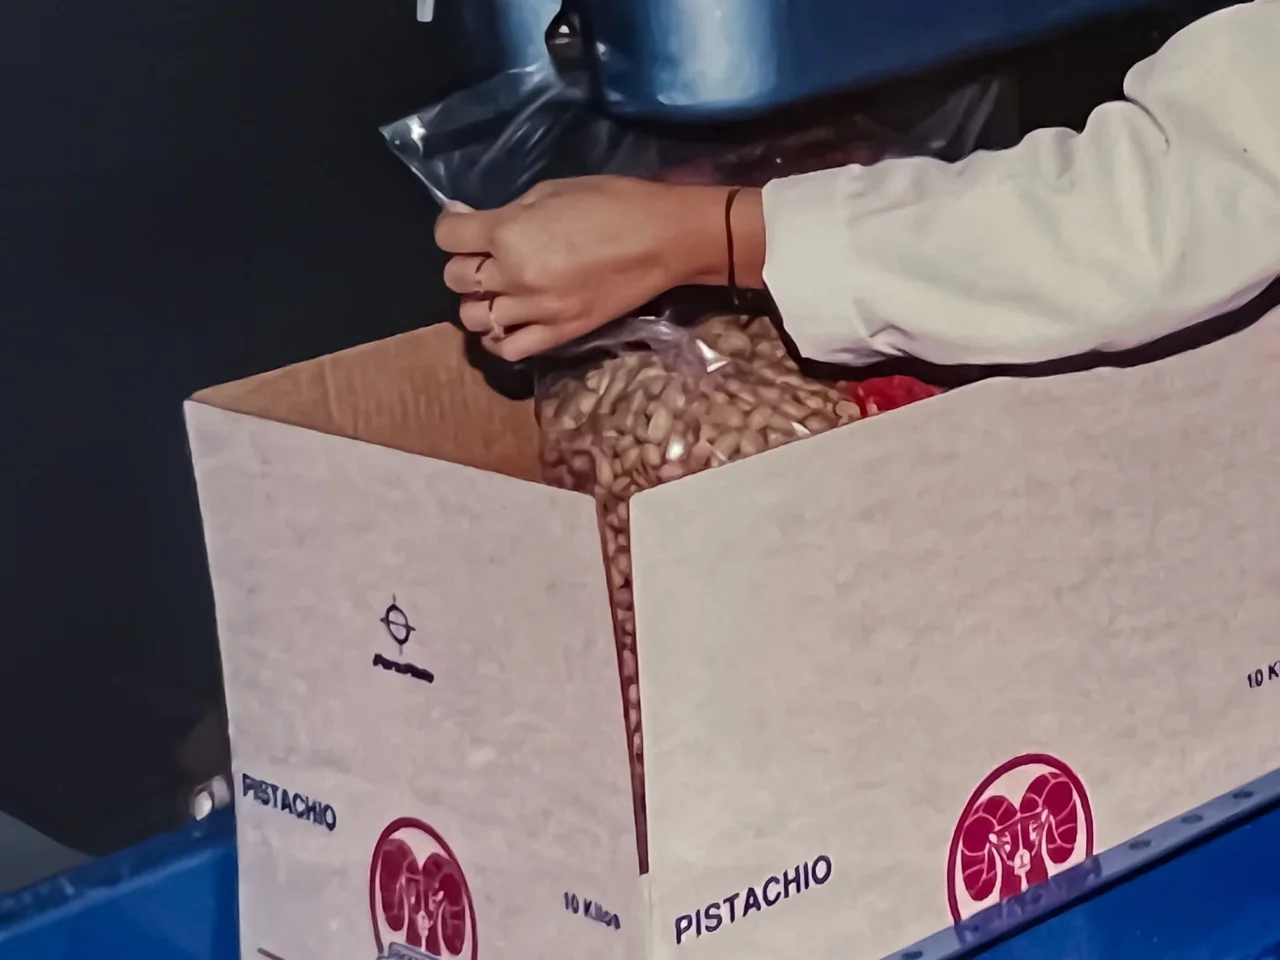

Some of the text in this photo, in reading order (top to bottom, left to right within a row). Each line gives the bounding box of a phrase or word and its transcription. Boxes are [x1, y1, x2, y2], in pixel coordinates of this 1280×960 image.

[1247, 668, 1264, 689] 10
[242, 772, 337, 832] PISTACHIO
[564, 891, 580, 915] 10
[674, 854, 832, 946] PISTACHIO
